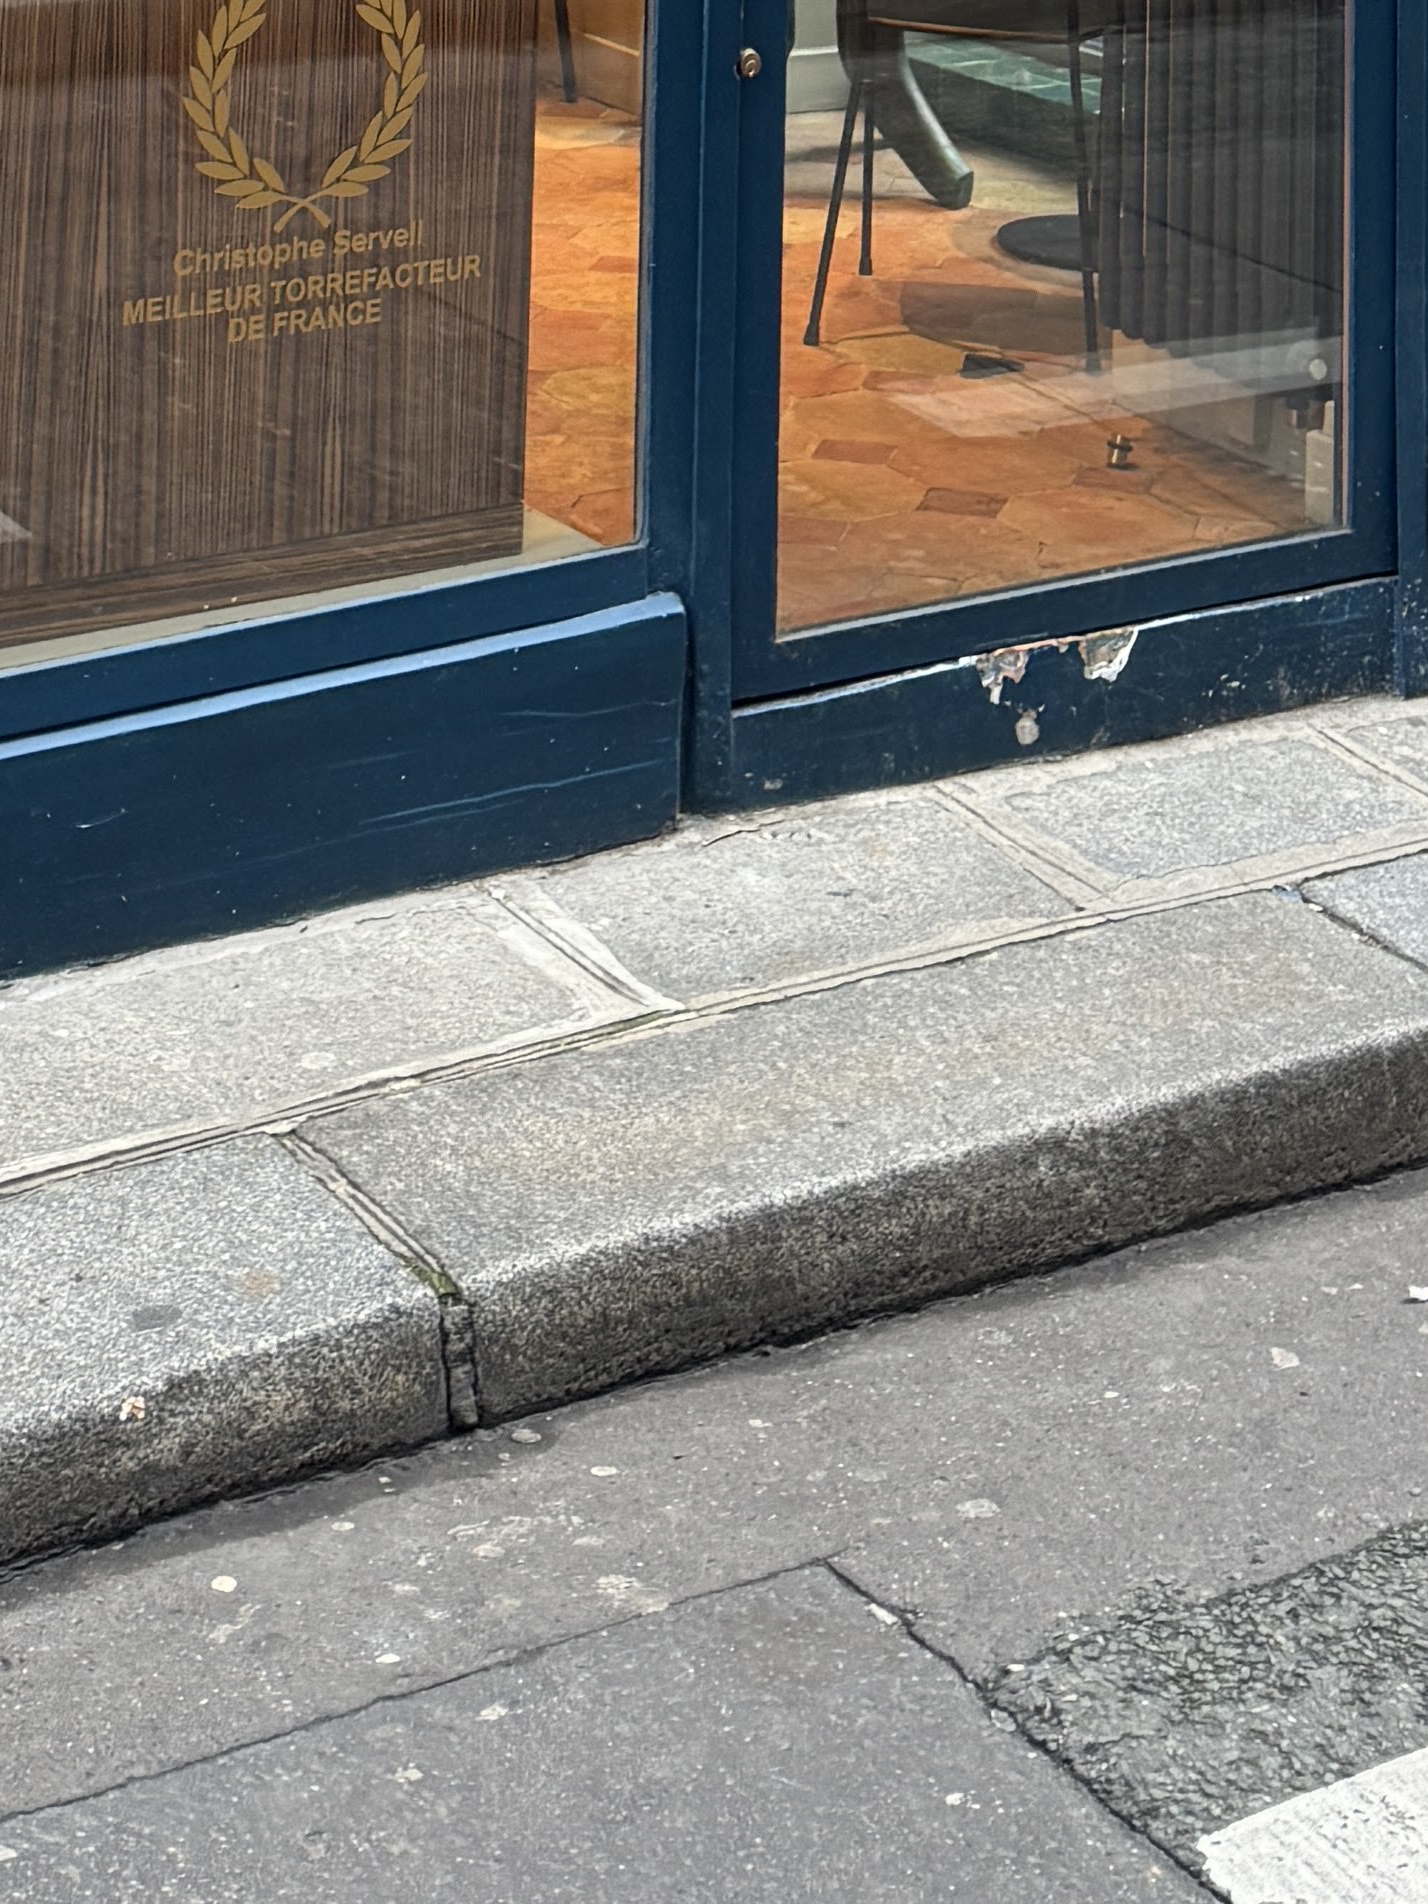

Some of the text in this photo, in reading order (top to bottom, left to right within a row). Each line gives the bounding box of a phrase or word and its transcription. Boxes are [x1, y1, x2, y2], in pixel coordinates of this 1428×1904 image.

[172, 235, 327, 276] Christophe
[122, 254, 482, 326] MEILLEUR TORREFACTEUR
[227, 298, 382, 344] DE FRANCE
